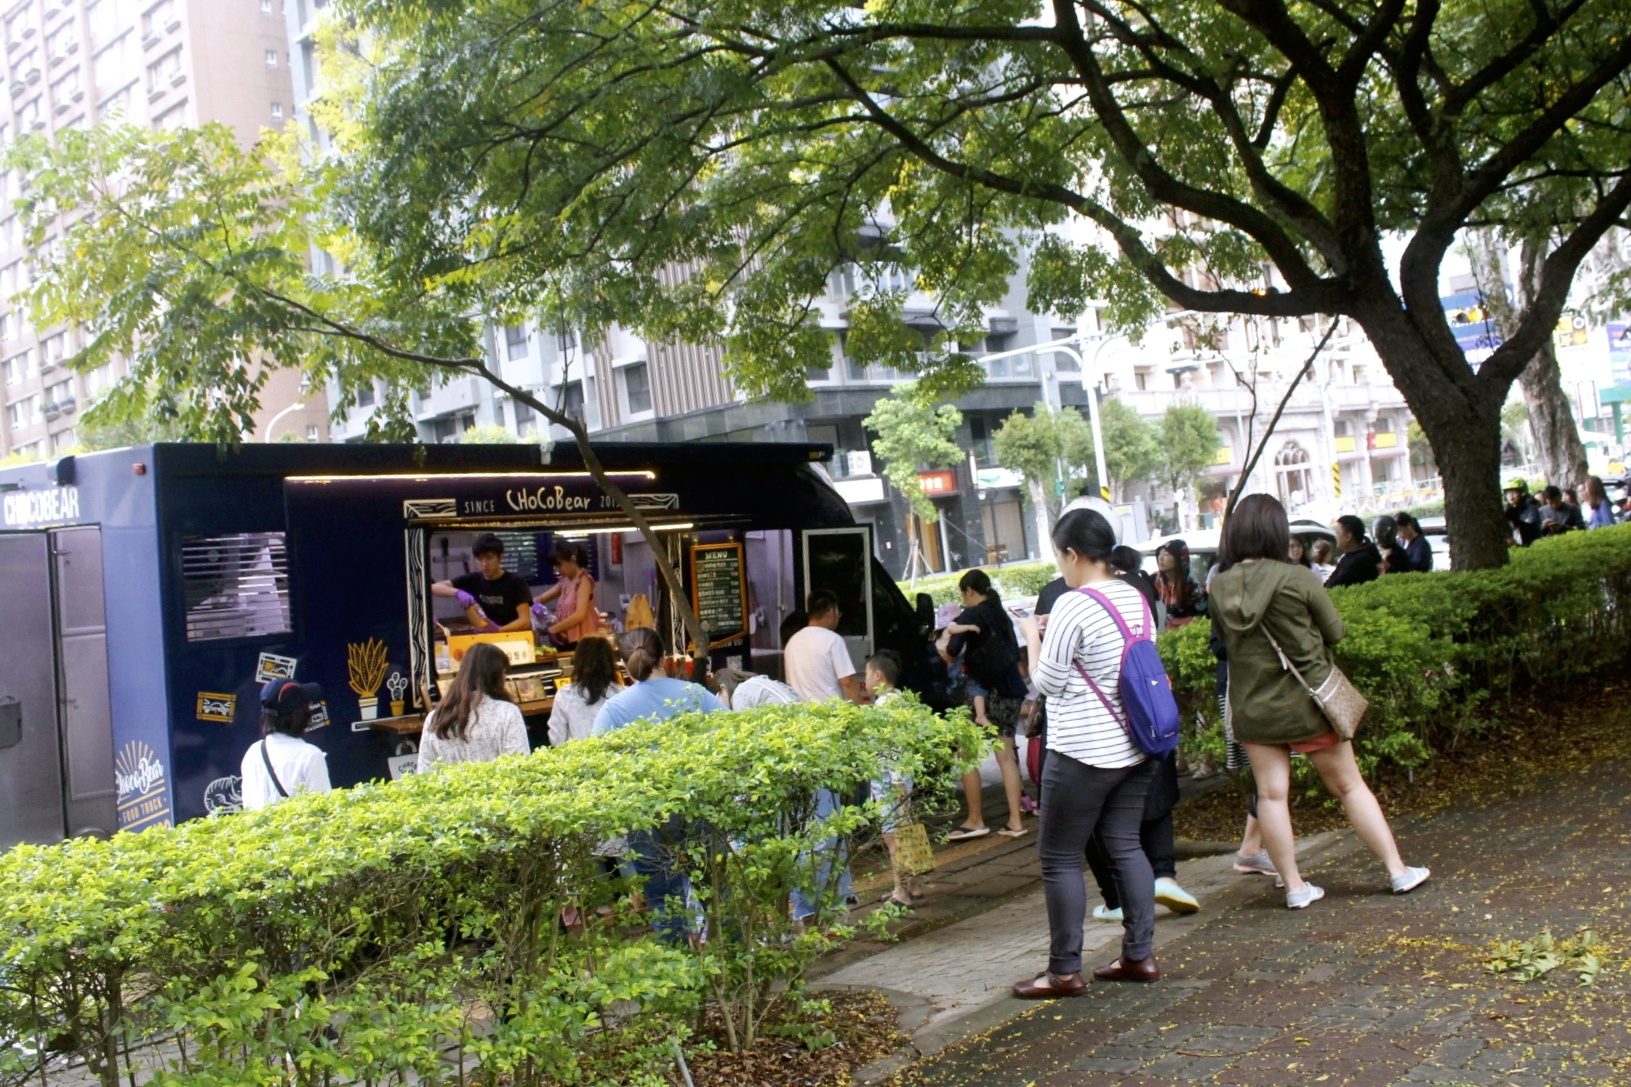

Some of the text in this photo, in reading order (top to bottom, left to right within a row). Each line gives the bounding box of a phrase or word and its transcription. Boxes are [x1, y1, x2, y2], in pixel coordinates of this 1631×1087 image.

[4, 486, 80, 526] CHOCOBEAR
[464, 500, 495, 514] SINCE
[705, 551, 728, 560] MENU
[122, 796, 162, 823] FOOD TRUCK
